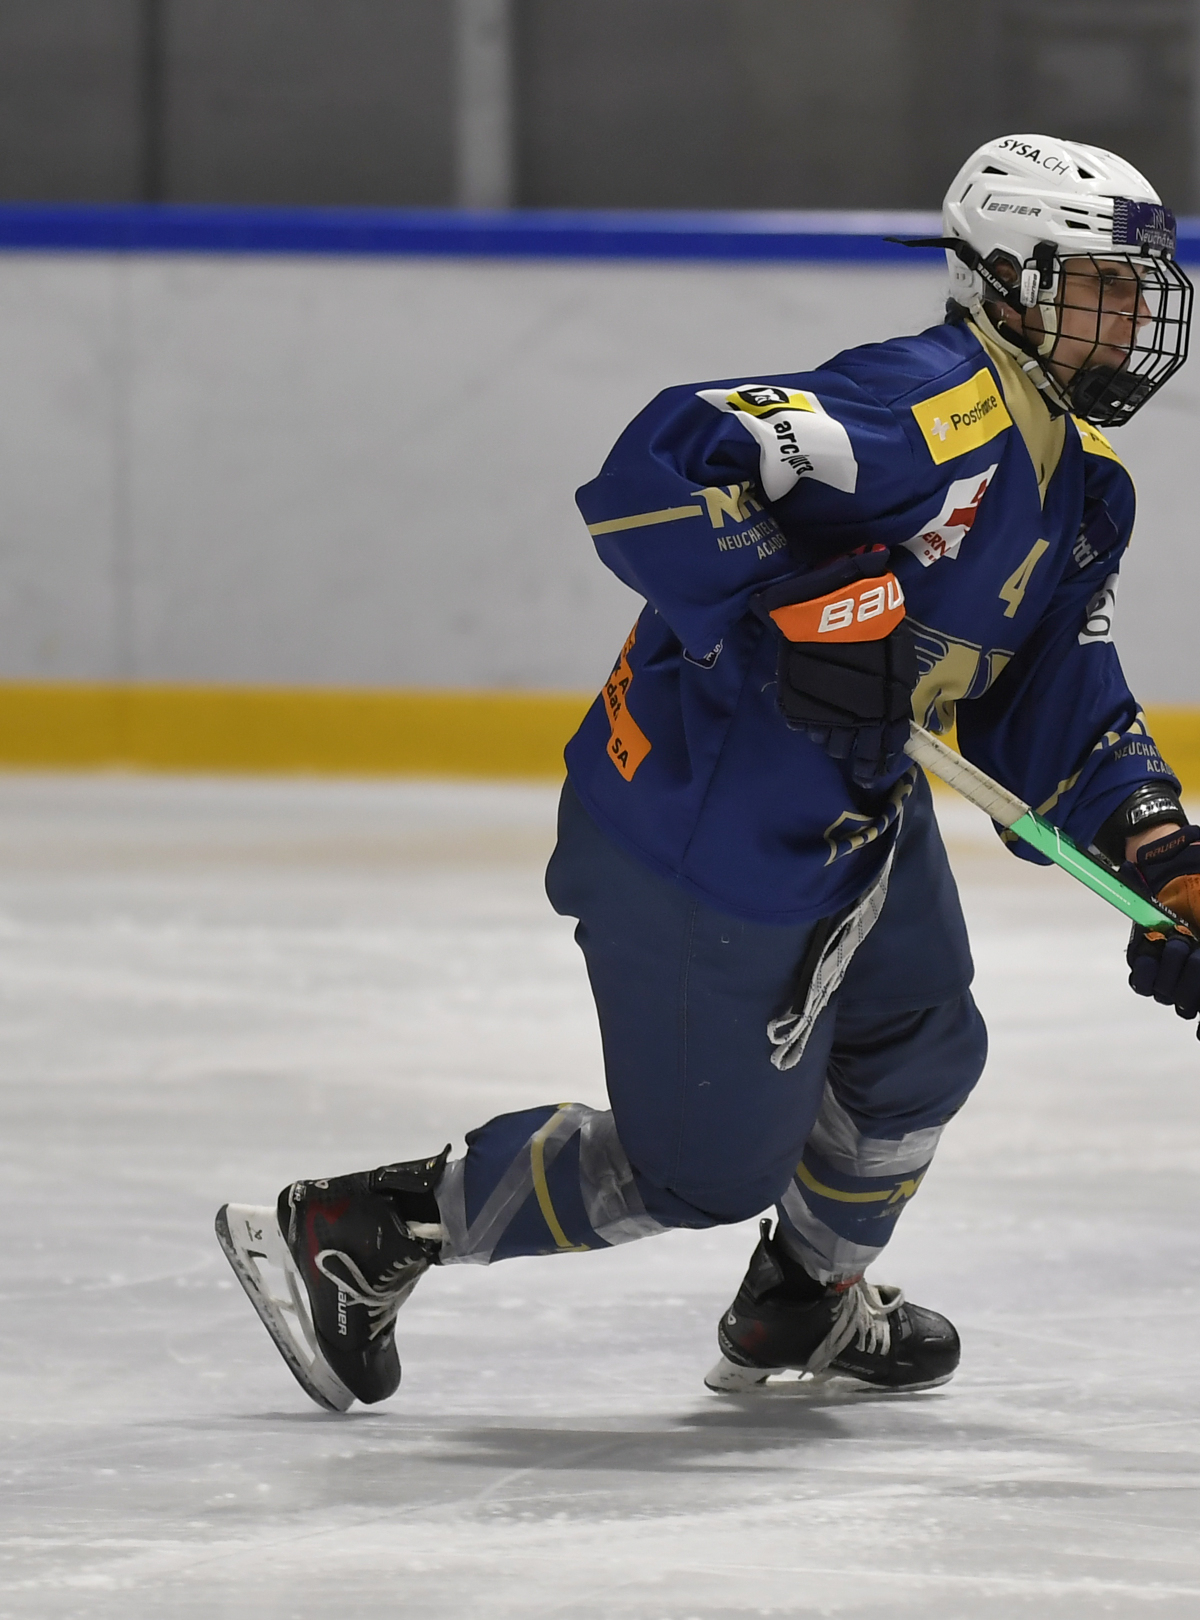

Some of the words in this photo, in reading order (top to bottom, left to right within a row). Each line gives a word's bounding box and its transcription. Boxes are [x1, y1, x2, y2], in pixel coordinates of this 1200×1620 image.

[998, 139, 1070, 176] SYSA.CH
[986, 202, 1042, 218] BAUER
[998, 538, 1050, 619] 4
